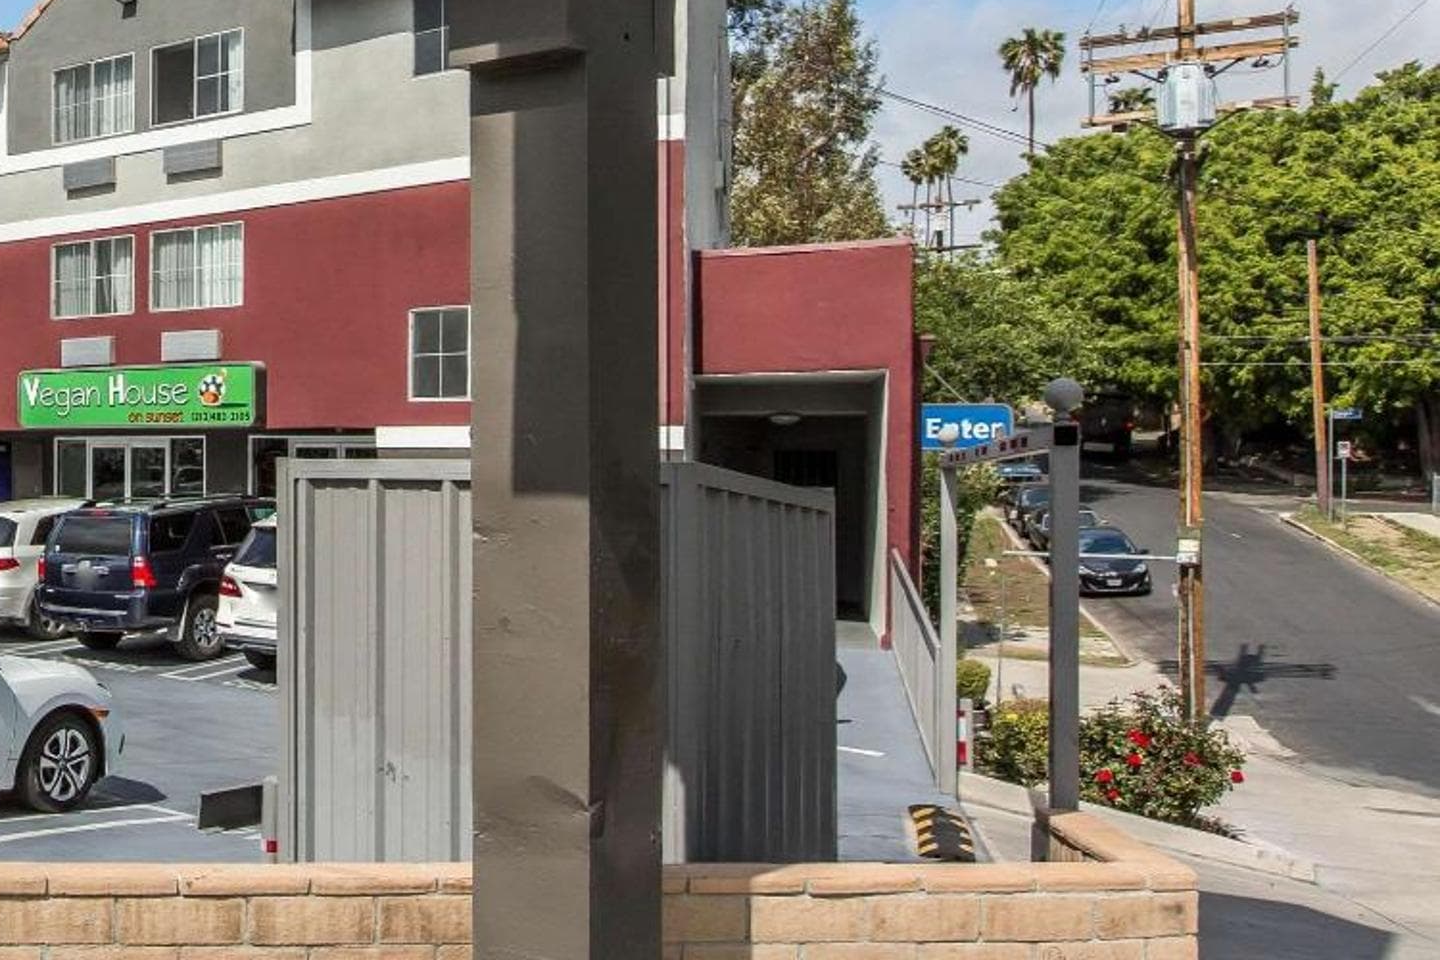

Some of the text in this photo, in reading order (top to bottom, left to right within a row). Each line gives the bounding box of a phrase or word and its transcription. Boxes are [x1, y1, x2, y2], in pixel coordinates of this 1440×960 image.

[23, 373, 188, 416] Vegan House
[128, 410, 185, 424] on sunset
